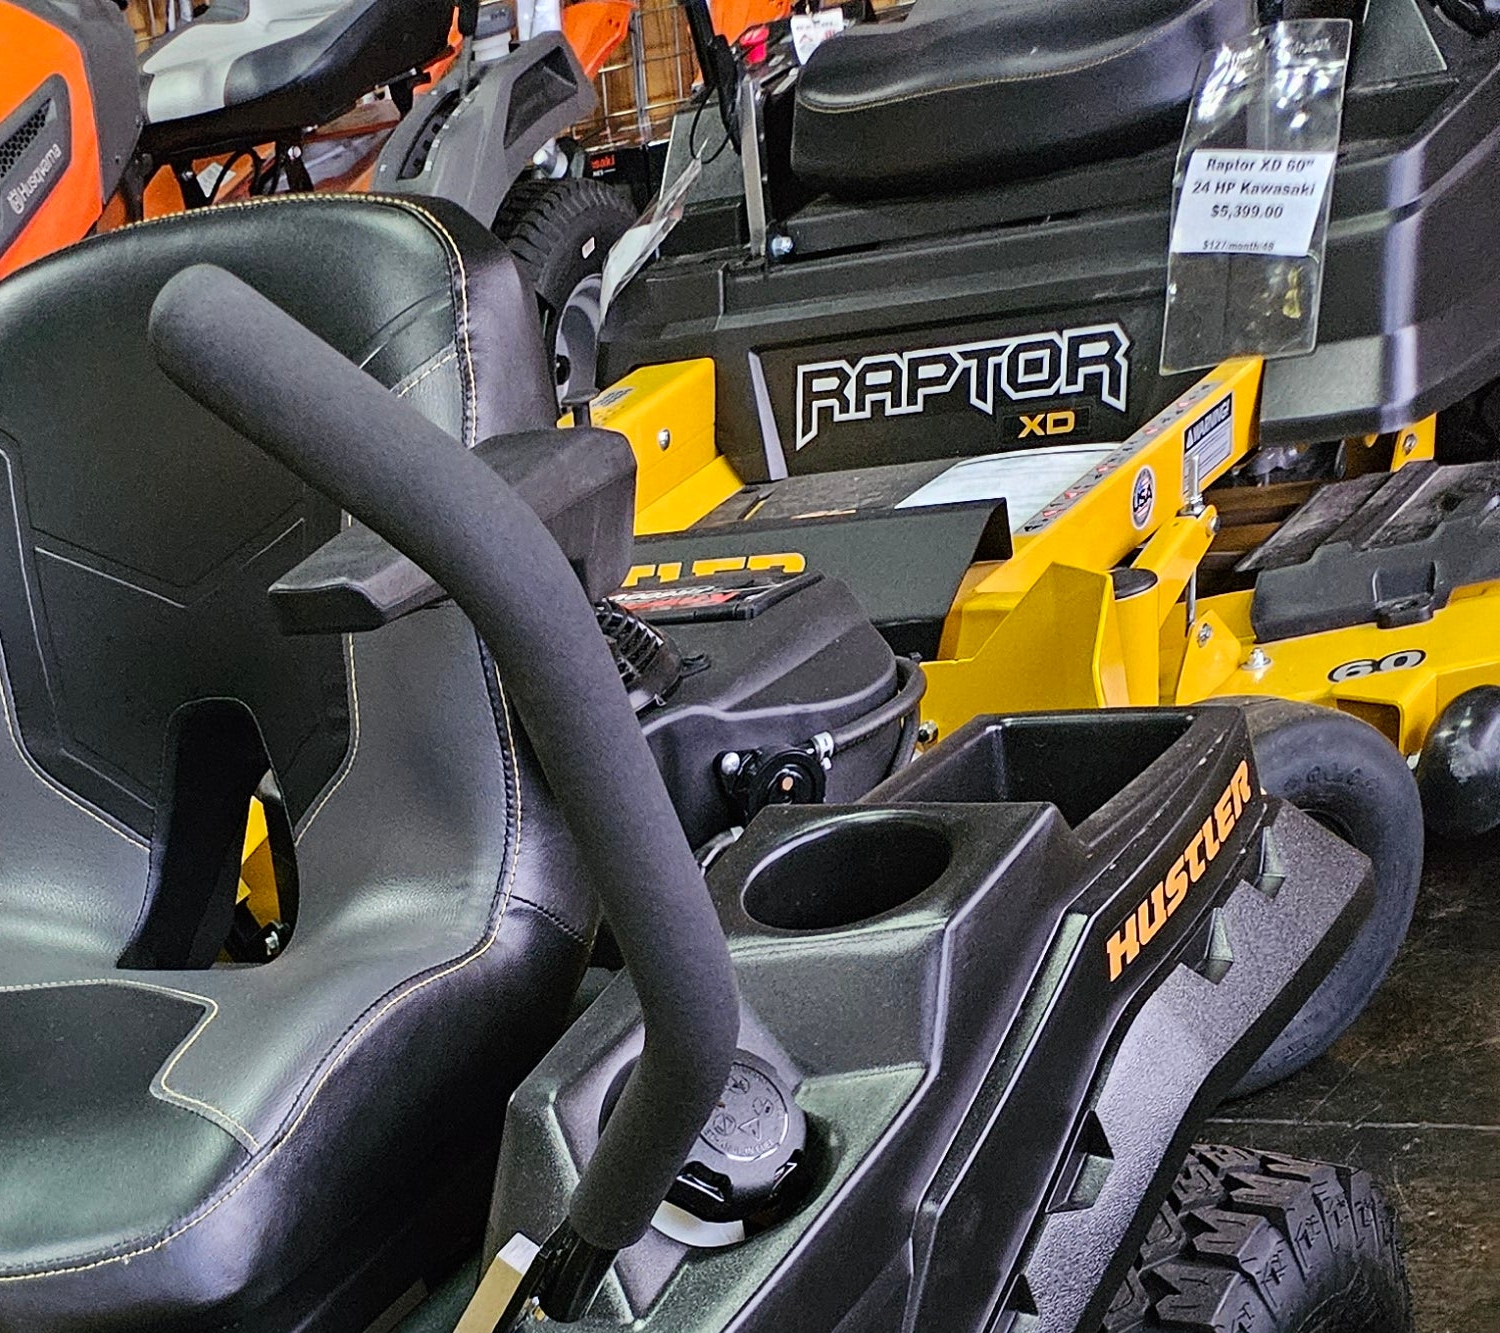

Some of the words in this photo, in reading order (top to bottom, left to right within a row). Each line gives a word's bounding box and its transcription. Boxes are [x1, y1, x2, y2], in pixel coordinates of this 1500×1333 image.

[17, 143, 62, 202] Husqvarna
[1206, 157, 1256, 175] Raptor
[1258, 158, 1282, 173] XD
[1192, 180, 1210, 195] 24
[1214, 182, 1237, 195] HP
[1240, 181, 1316, 197] Kawasaki
[1210, 204, 1284, 221] $5,399.00
[796, 322, 1130, 451] RAPTOR
[1018, 410, 1076, 438] XD
[1329, 650, 1426, 683] 60
[1107, 759, 1252, 983] HUSTLER
